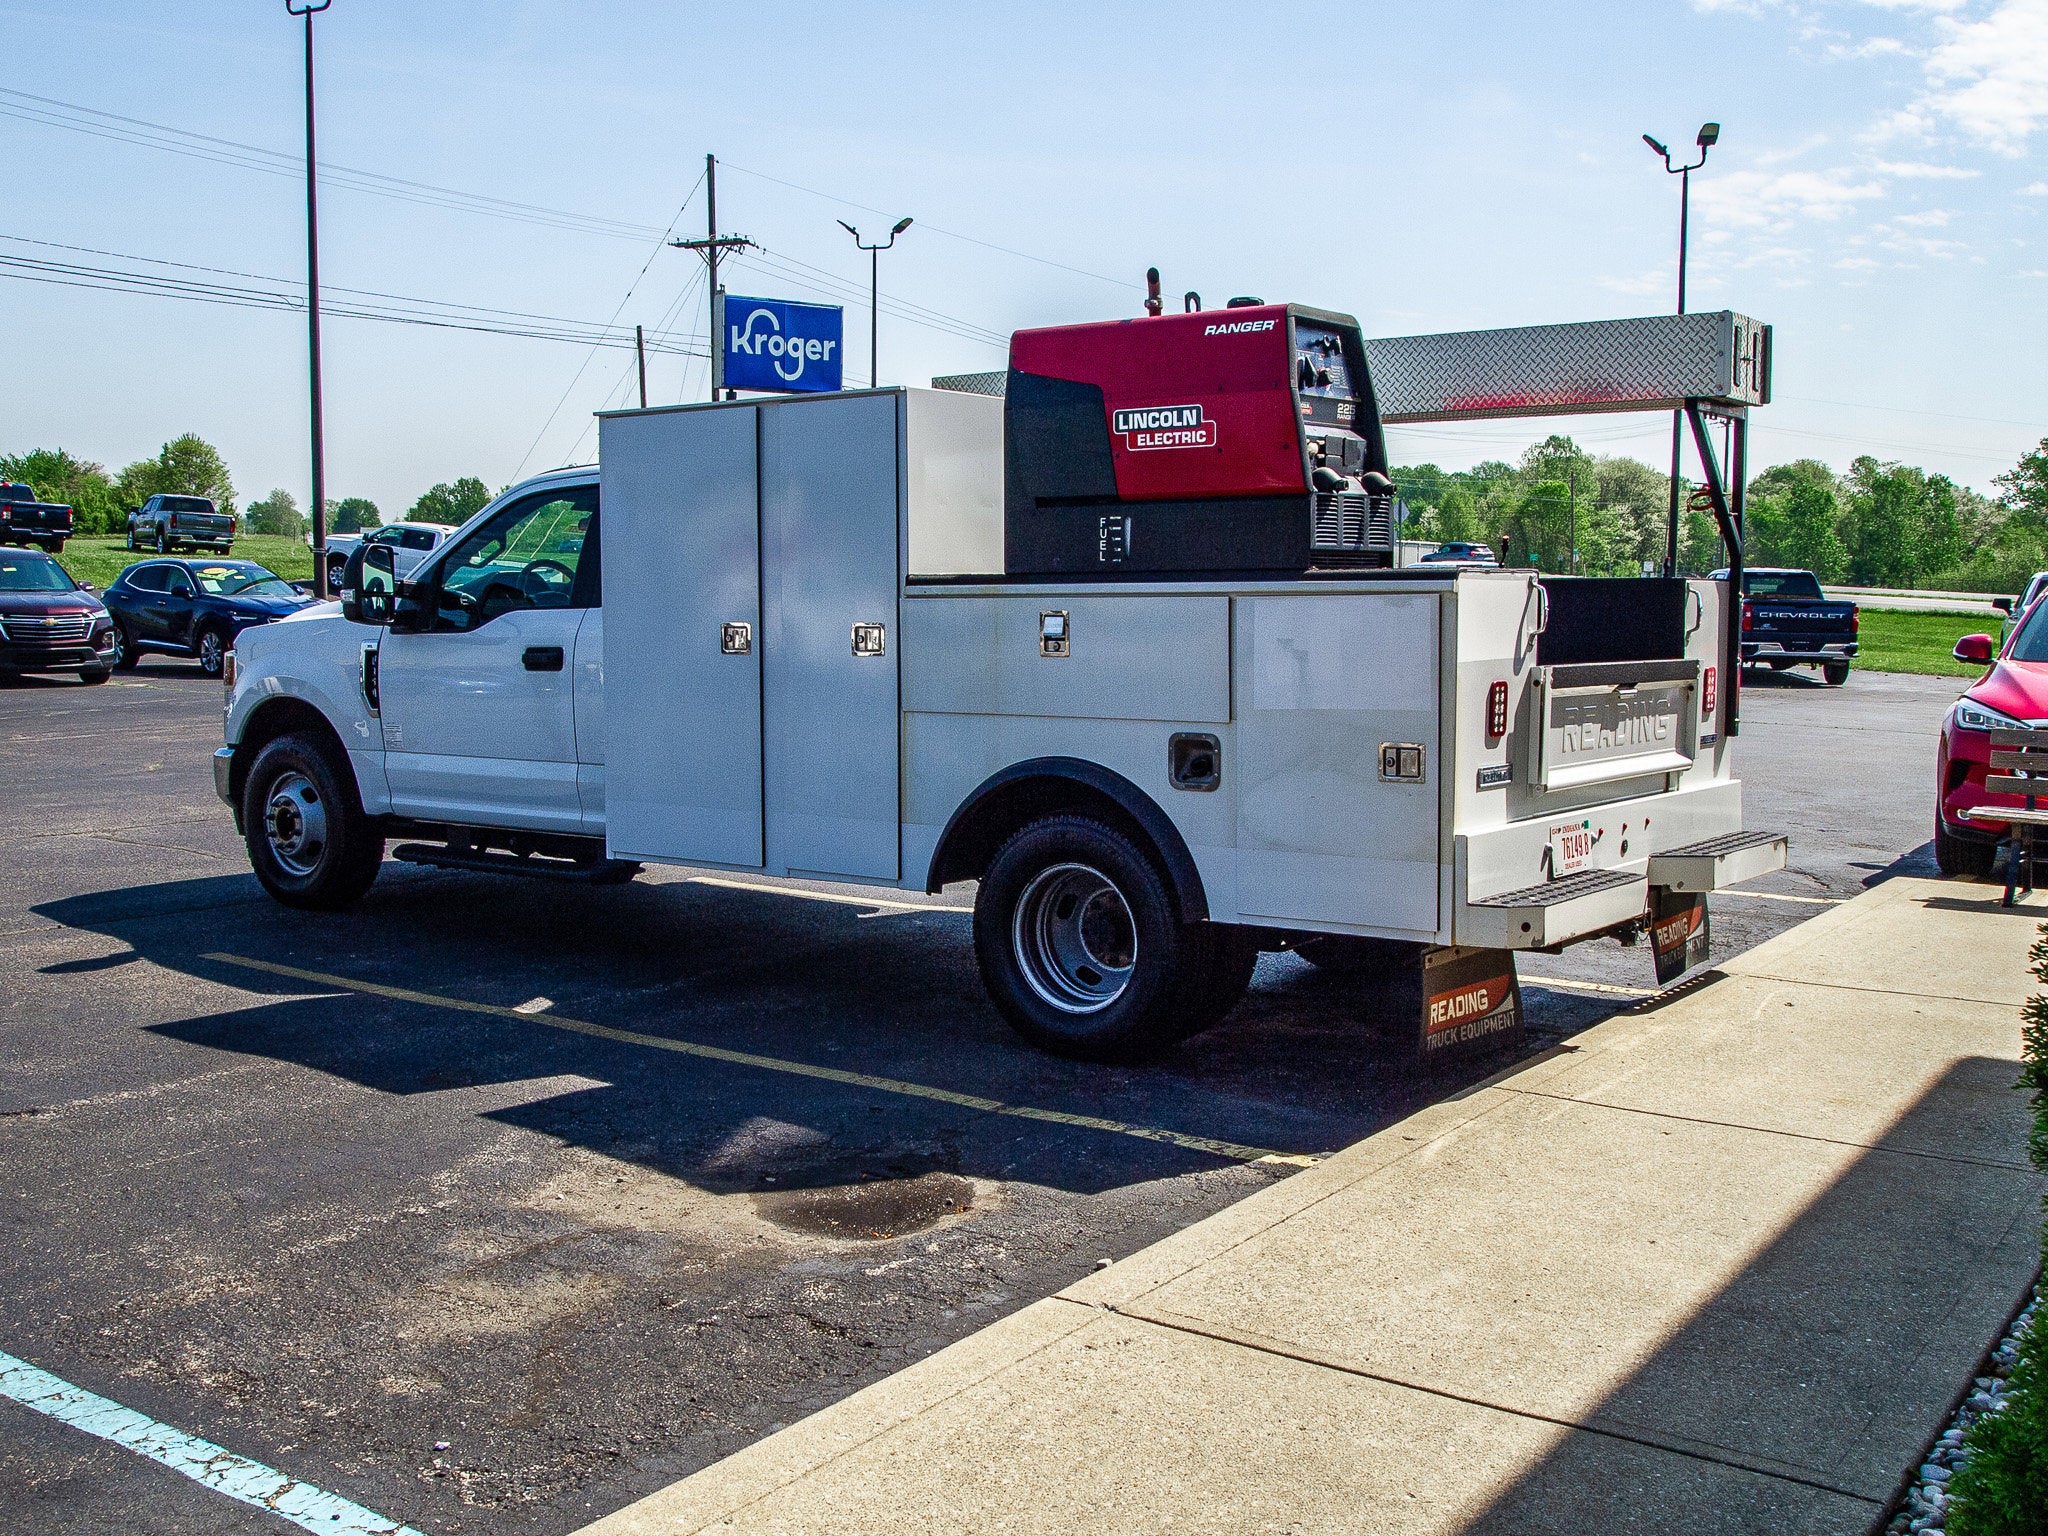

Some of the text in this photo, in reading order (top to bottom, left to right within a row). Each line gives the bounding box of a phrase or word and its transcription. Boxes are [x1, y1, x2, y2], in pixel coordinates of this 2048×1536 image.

[1204, 320, 1275, 336] RANGER
[731, 308, 836, 381] Kroger
[1118, 409, 1197, 430] LINCOLN
[1137, 430, 1207, 447] ELECTRIC
[1099, 517, 1108, 562] FUEL
[1759, 611, 1846, 619] CHEVROLET
[1561, 699, 1671, 753] READING
[1562, 834, 1583, 860] 76149
[1657, 918, 1688, 947] READING
[1430, 988, 1489, 1026] READING
[1427, 1010, 1515, 1050] TRUCK EQUIPMENT
